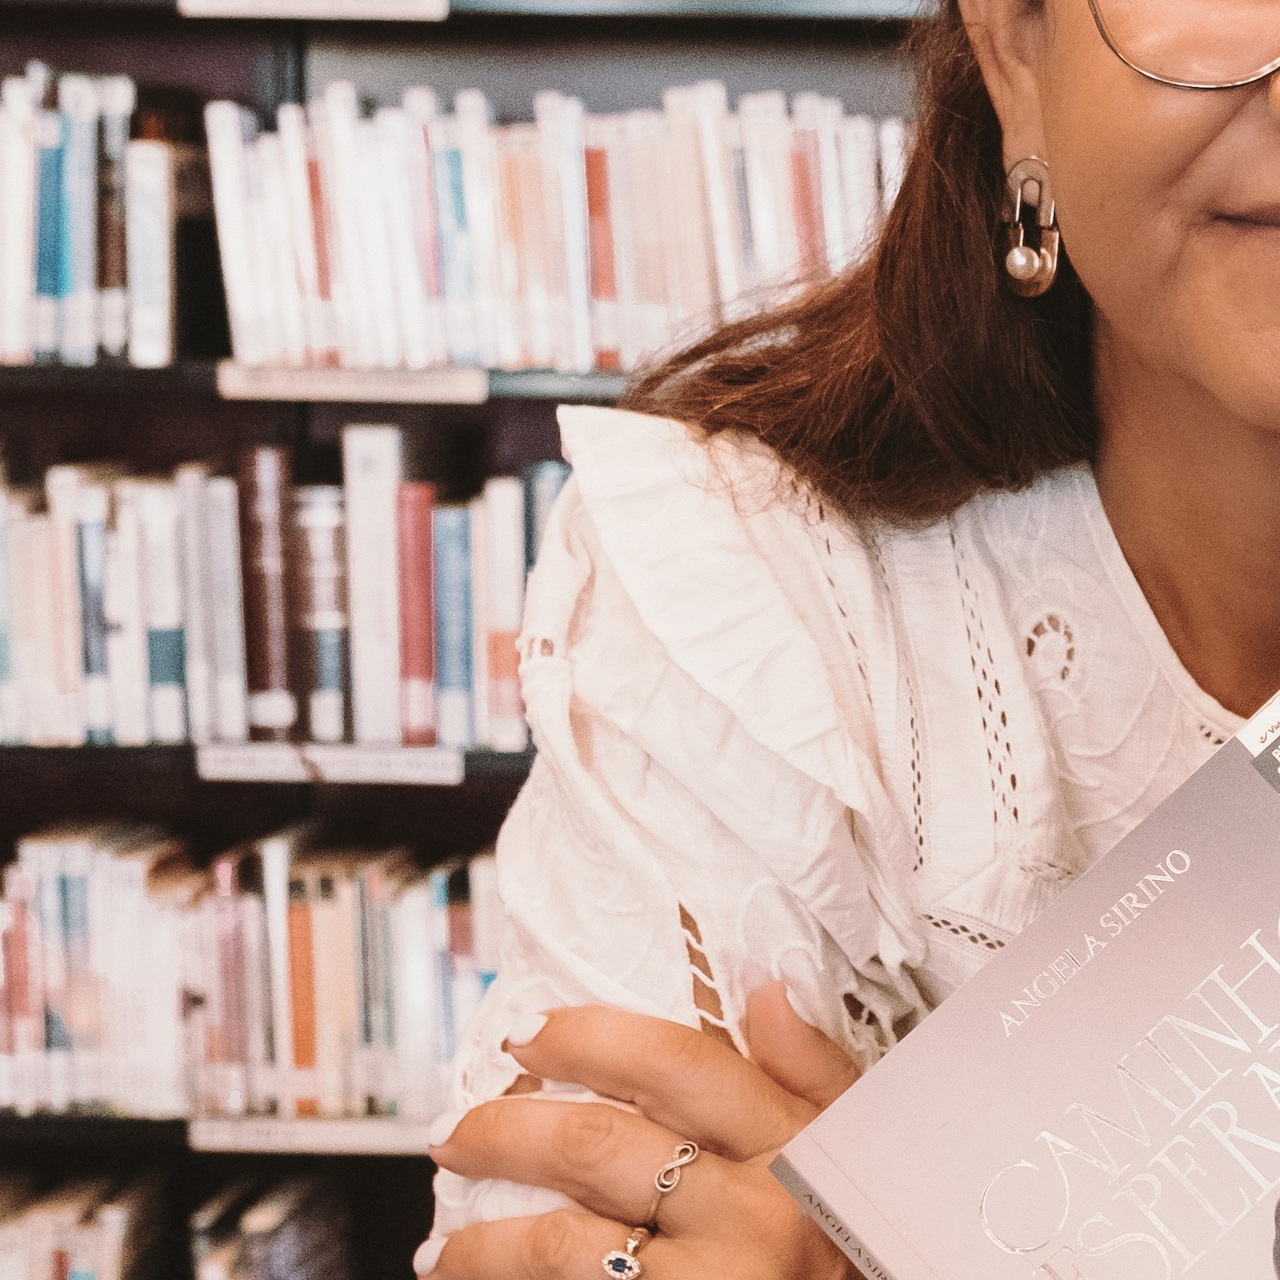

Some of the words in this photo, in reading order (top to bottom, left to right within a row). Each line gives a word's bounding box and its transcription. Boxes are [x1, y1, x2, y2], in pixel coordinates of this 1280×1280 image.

[999, 933, 1109, 1038] ANGELA
[1099, 849, 1191, 938] SIRINO
[803, 1193, 863, 1258] ANGELA
